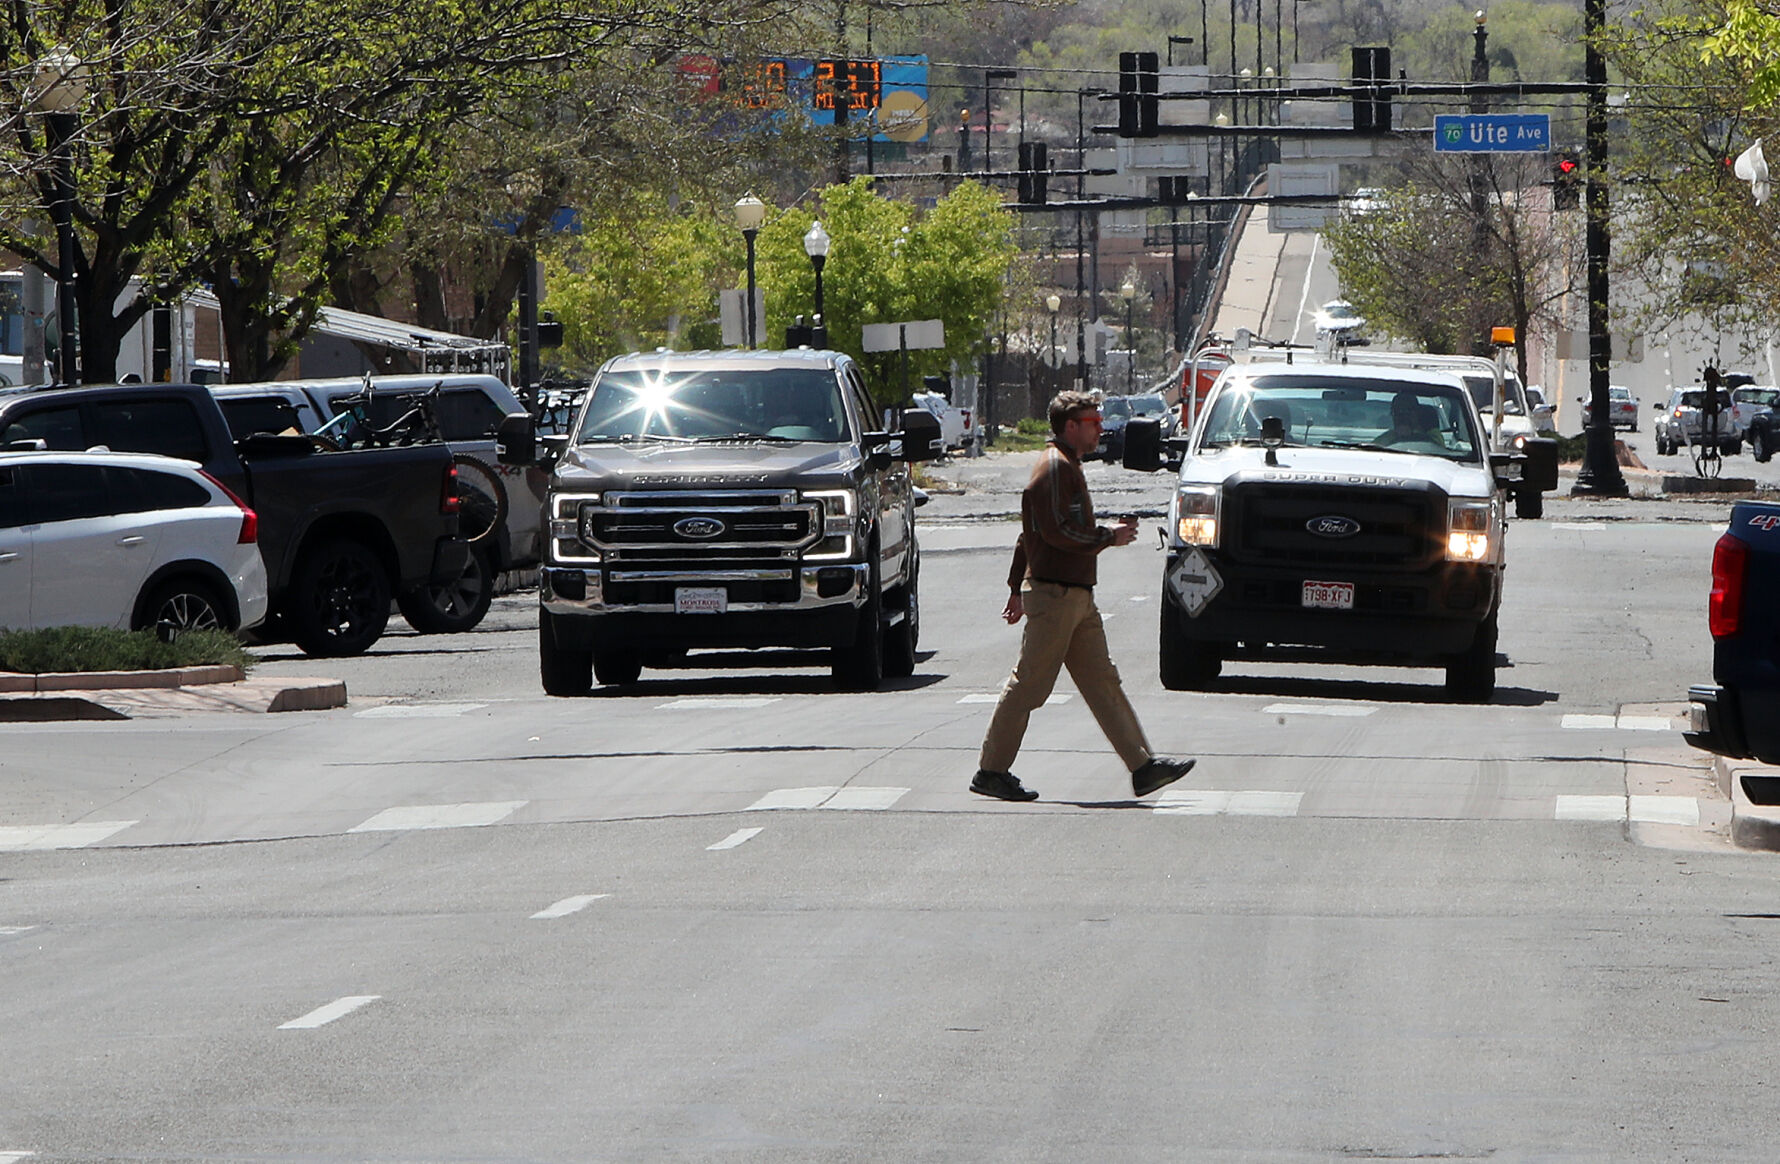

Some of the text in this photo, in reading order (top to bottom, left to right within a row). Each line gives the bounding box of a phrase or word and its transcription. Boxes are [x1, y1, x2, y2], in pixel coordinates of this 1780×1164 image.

[1446, 122, 1542, 144] 70 Ute Ave
[1264, 472, 1407, 487] SUPER DUTY
[685, 521, 714, 533] Ford
[1318, 519, 1348, 533] Ford
